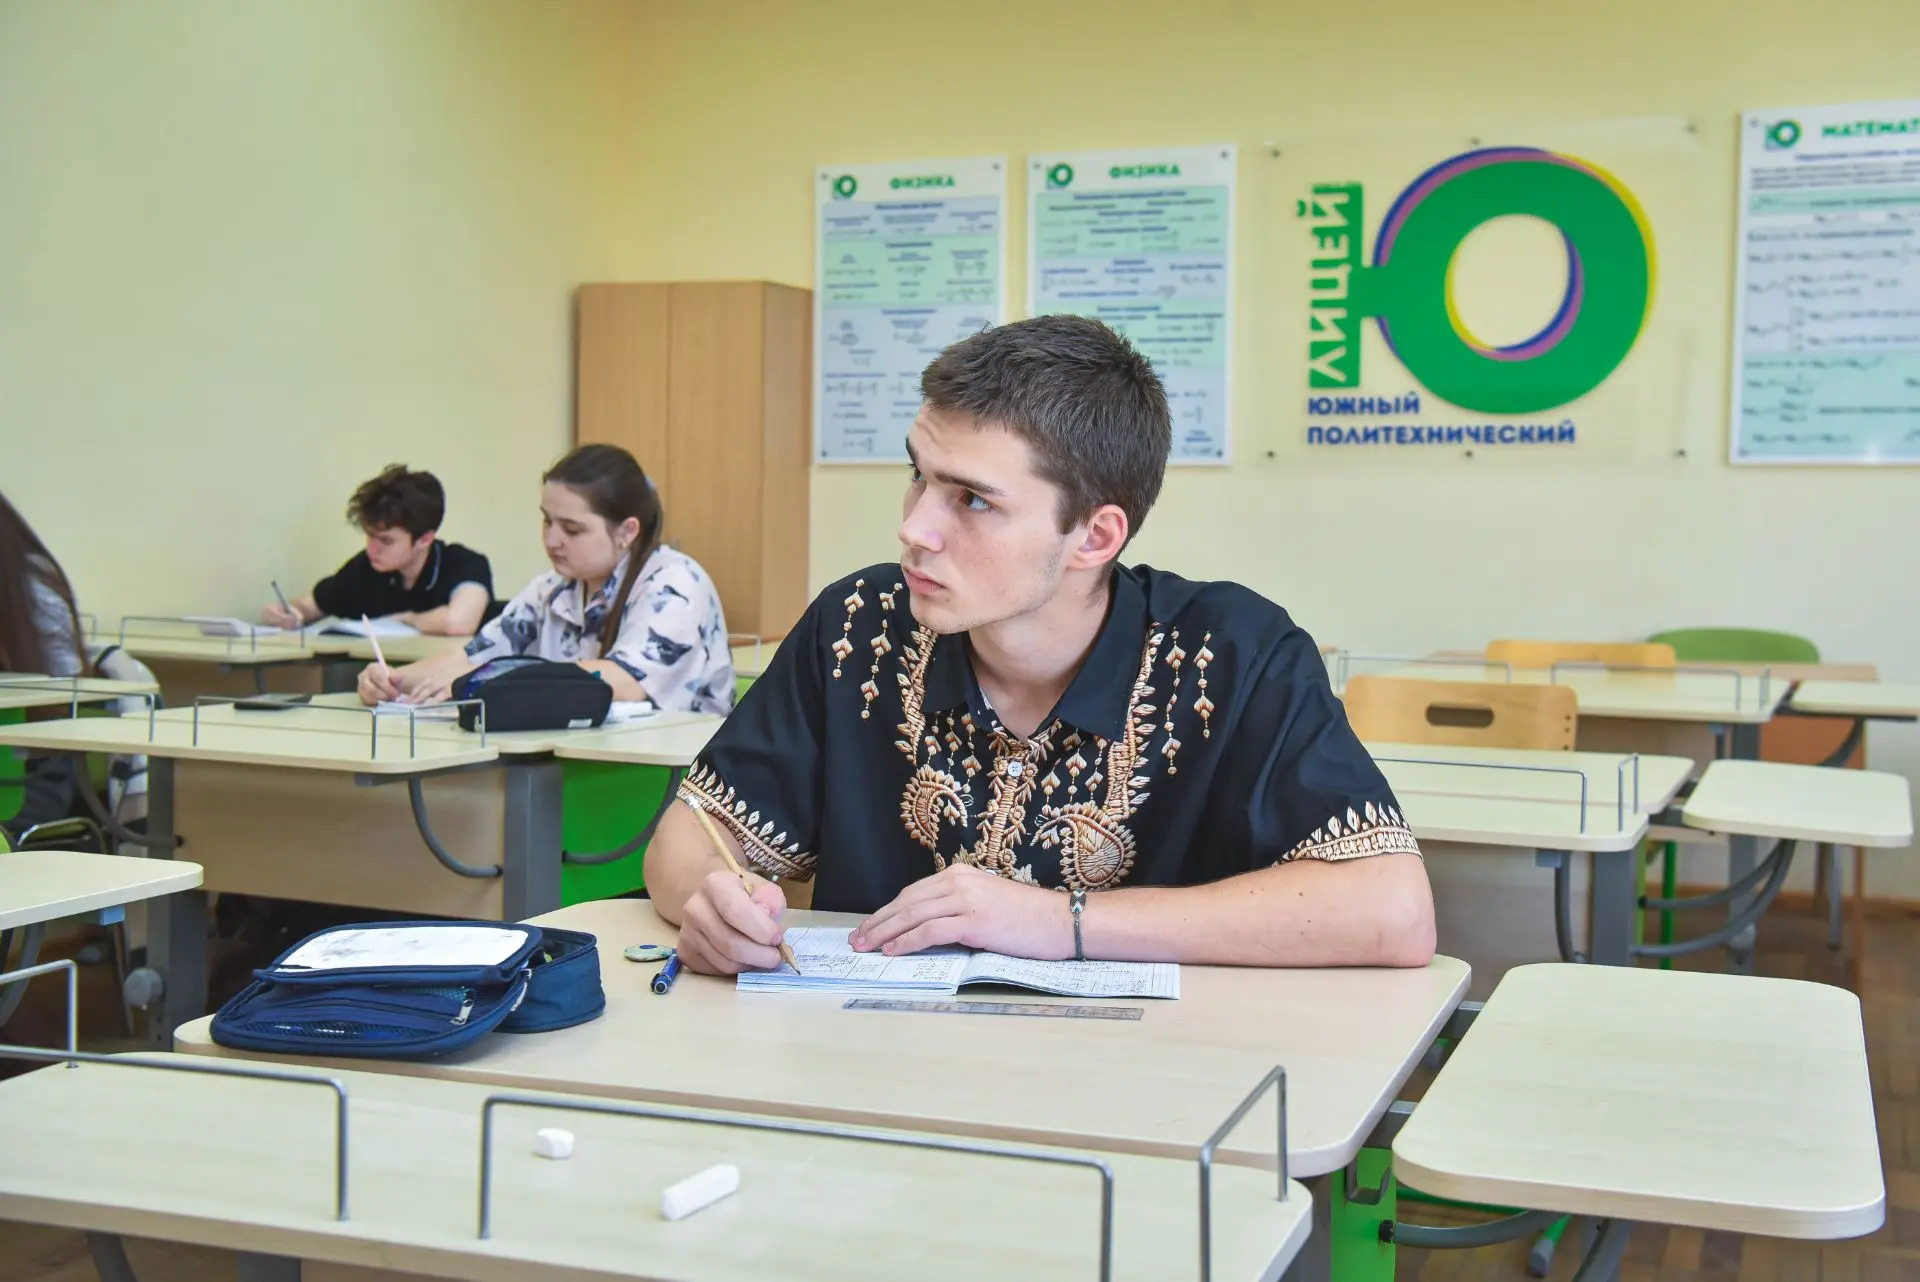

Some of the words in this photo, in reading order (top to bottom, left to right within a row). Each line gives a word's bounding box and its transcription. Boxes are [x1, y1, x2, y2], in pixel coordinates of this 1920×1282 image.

[1297, 190, 1352, 383] ЛИЦЕЙ
[1307, 391, 1420, 416] ЮЖНЫЙ
[1307, 419, 1576, 445] ПОЛИТЕХНИЧЕСКИЙ
